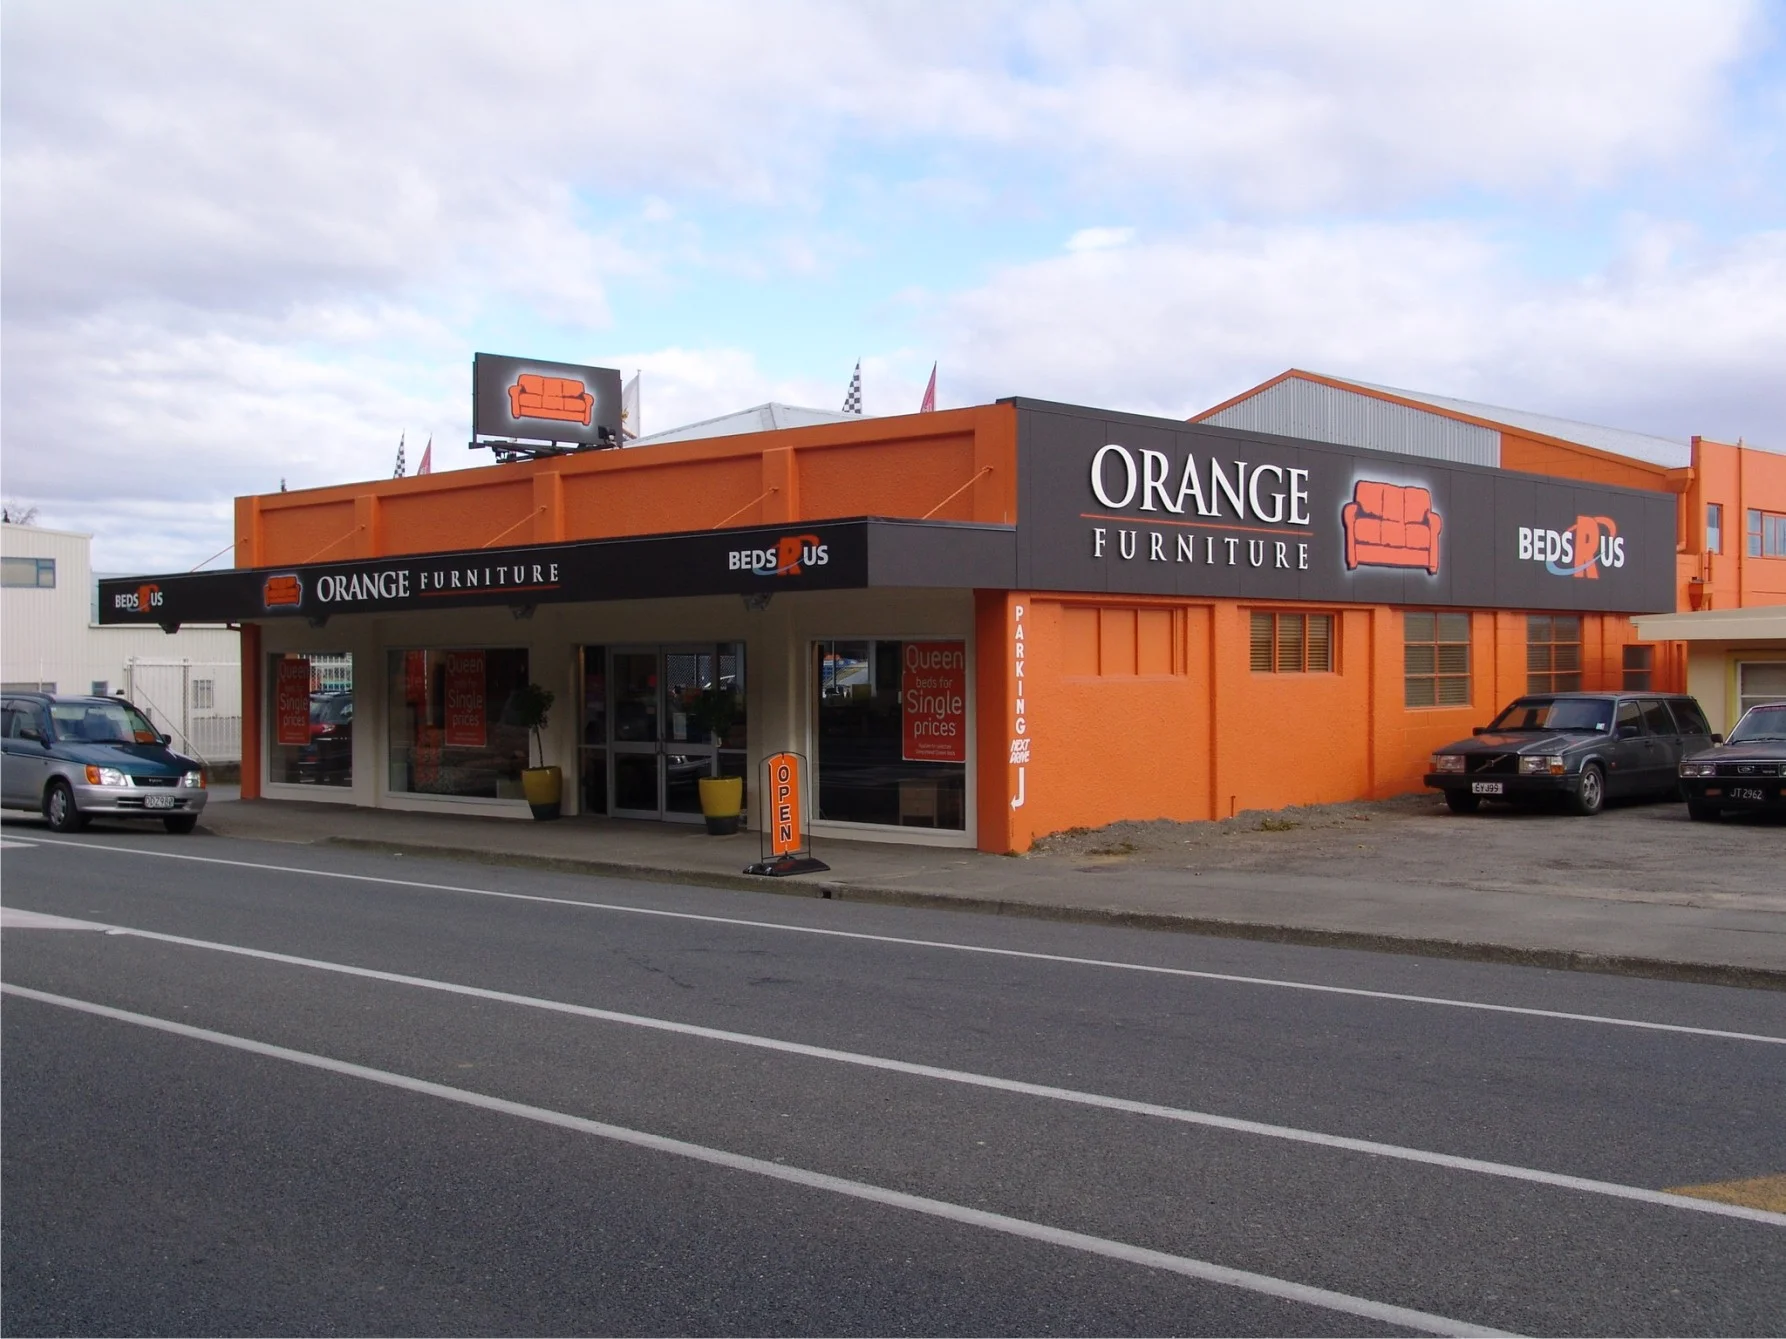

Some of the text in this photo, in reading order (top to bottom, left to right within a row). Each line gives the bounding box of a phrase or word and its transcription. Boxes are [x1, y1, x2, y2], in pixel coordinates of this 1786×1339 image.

[1090, 443, 1311, 525] ORANGE
[728, 536, 829, 577] BEDS R US
[1092, 527, 1309, 570] FURNITURE
[1518, 515, 1625, 579] BEDS R US
[316, 563, 559, 602] ORANGE FURNITURE
[115, 592, 139, 608] BEDS
[150, 591, 164, 606] US
[446, 653, 483, 676] Queen
[905, 644, 964, 673] Queen
[1015, 605, 1026, 735] PARKING
[279, 661, 310, 682] Queen
[916, 676, 953, 689] beds for
[279, 692, 309, 715] Single
[448, 689, 484, 713] Single
[906, 688, 962, 719] Single
[282, 712, 306, 728] prices
[452, 712, 480, 729] prices
[913, 717, 957, 739] prices
[1010, 738, 1031, 752] NEXT
[777, 764, 793, 844] OPEN
